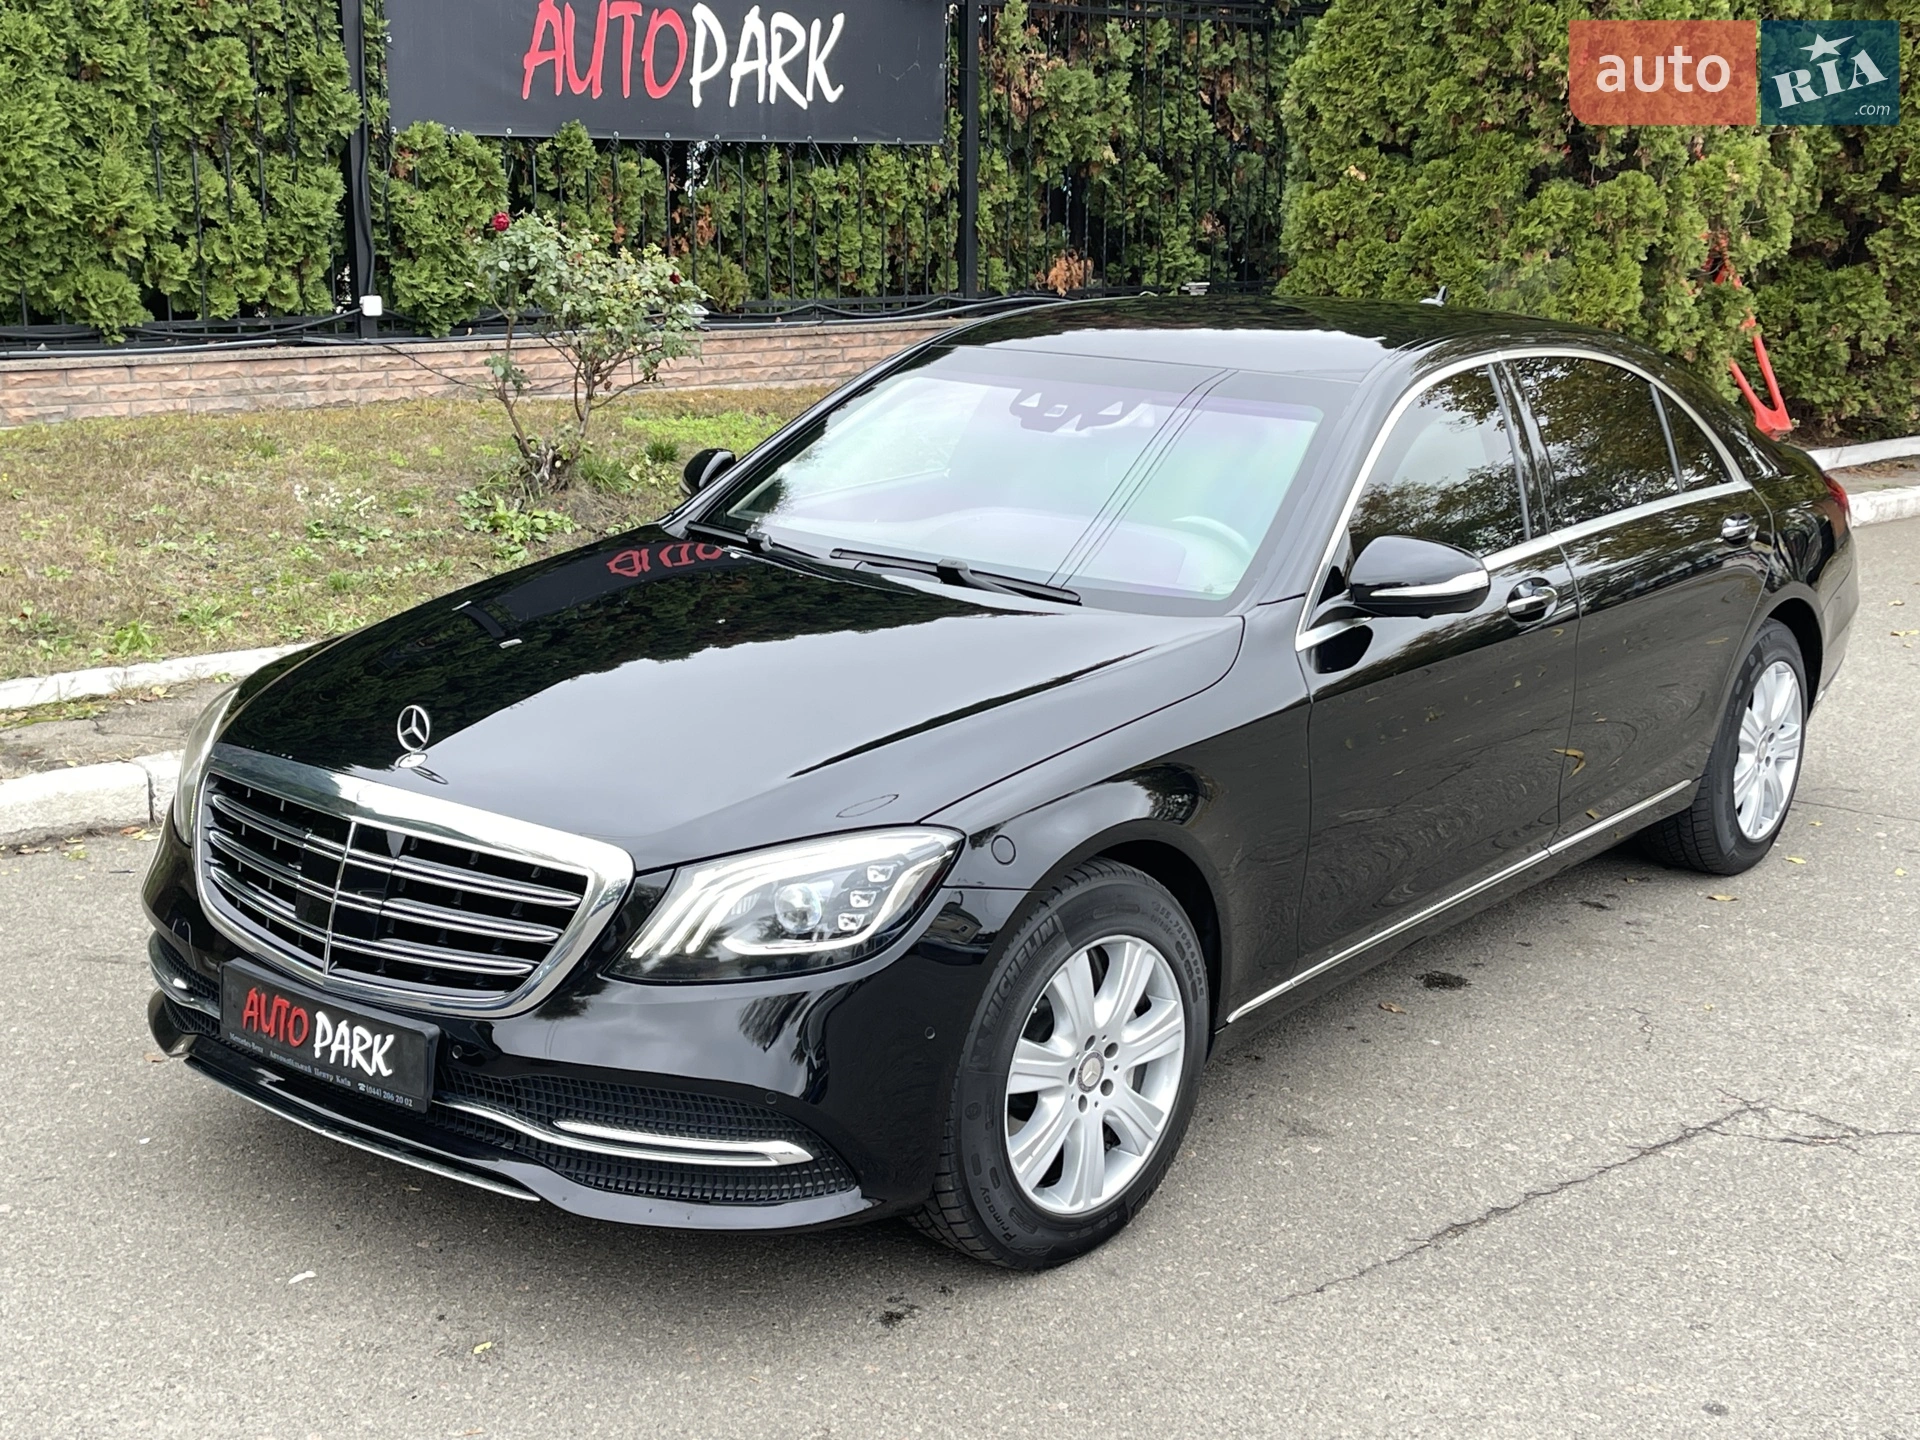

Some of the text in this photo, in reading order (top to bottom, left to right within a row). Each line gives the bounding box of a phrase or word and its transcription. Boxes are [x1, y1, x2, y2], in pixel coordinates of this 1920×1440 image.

[982, 917, 1056, 1032] MICHELIN
[382, 1090, 394, 1101] 206
[980, 1186, 1017, 1242] Primacy
